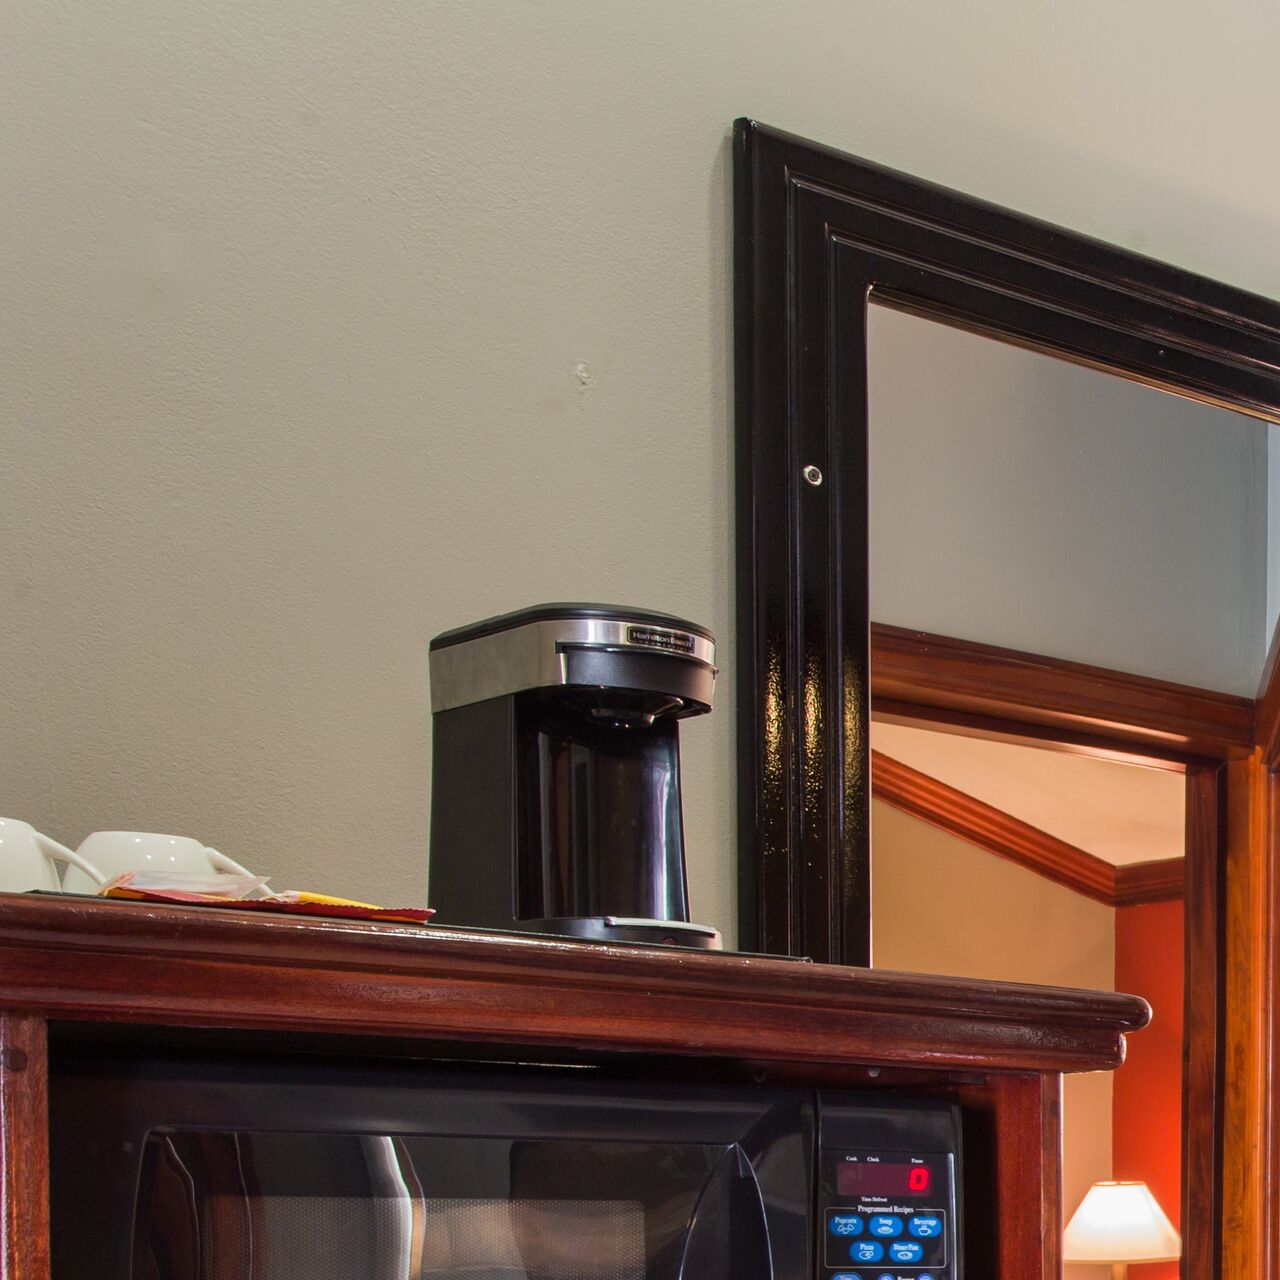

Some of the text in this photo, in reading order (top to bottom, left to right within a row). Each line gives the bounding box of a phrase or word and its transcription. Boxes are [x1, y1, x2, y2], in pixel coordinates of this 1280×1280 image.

[909, 1167, 929, 1191] 0
[857, 1204, 914, 1215] Programmed Recipes
